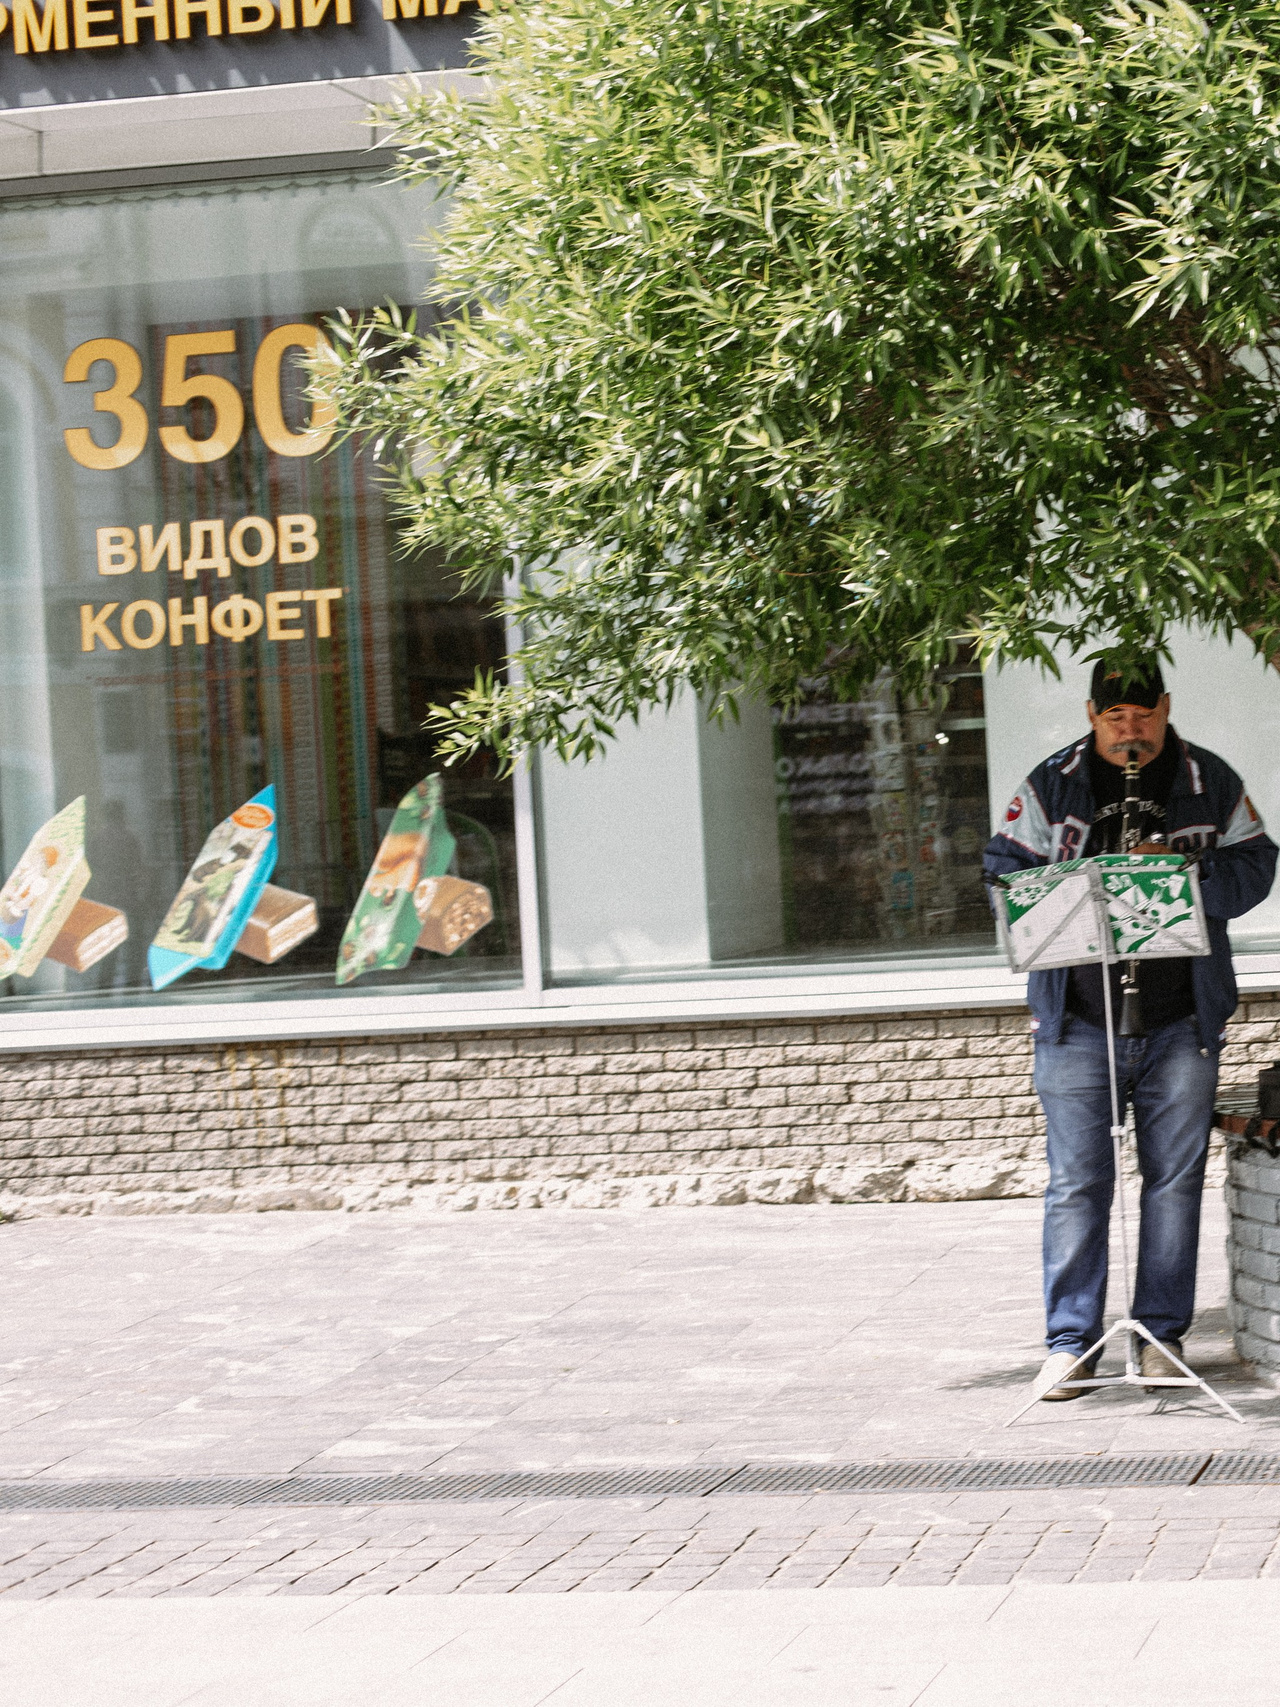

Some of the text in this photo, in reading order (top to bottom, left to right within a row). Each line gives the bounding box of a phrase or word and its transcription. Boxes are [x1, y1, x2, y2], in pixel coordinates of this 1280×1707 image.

[63, 323, 337, 471] 350
[96, 513, 320, 580] ВИДОВ
[79, 587, 343, 652] КОНФЕТ
